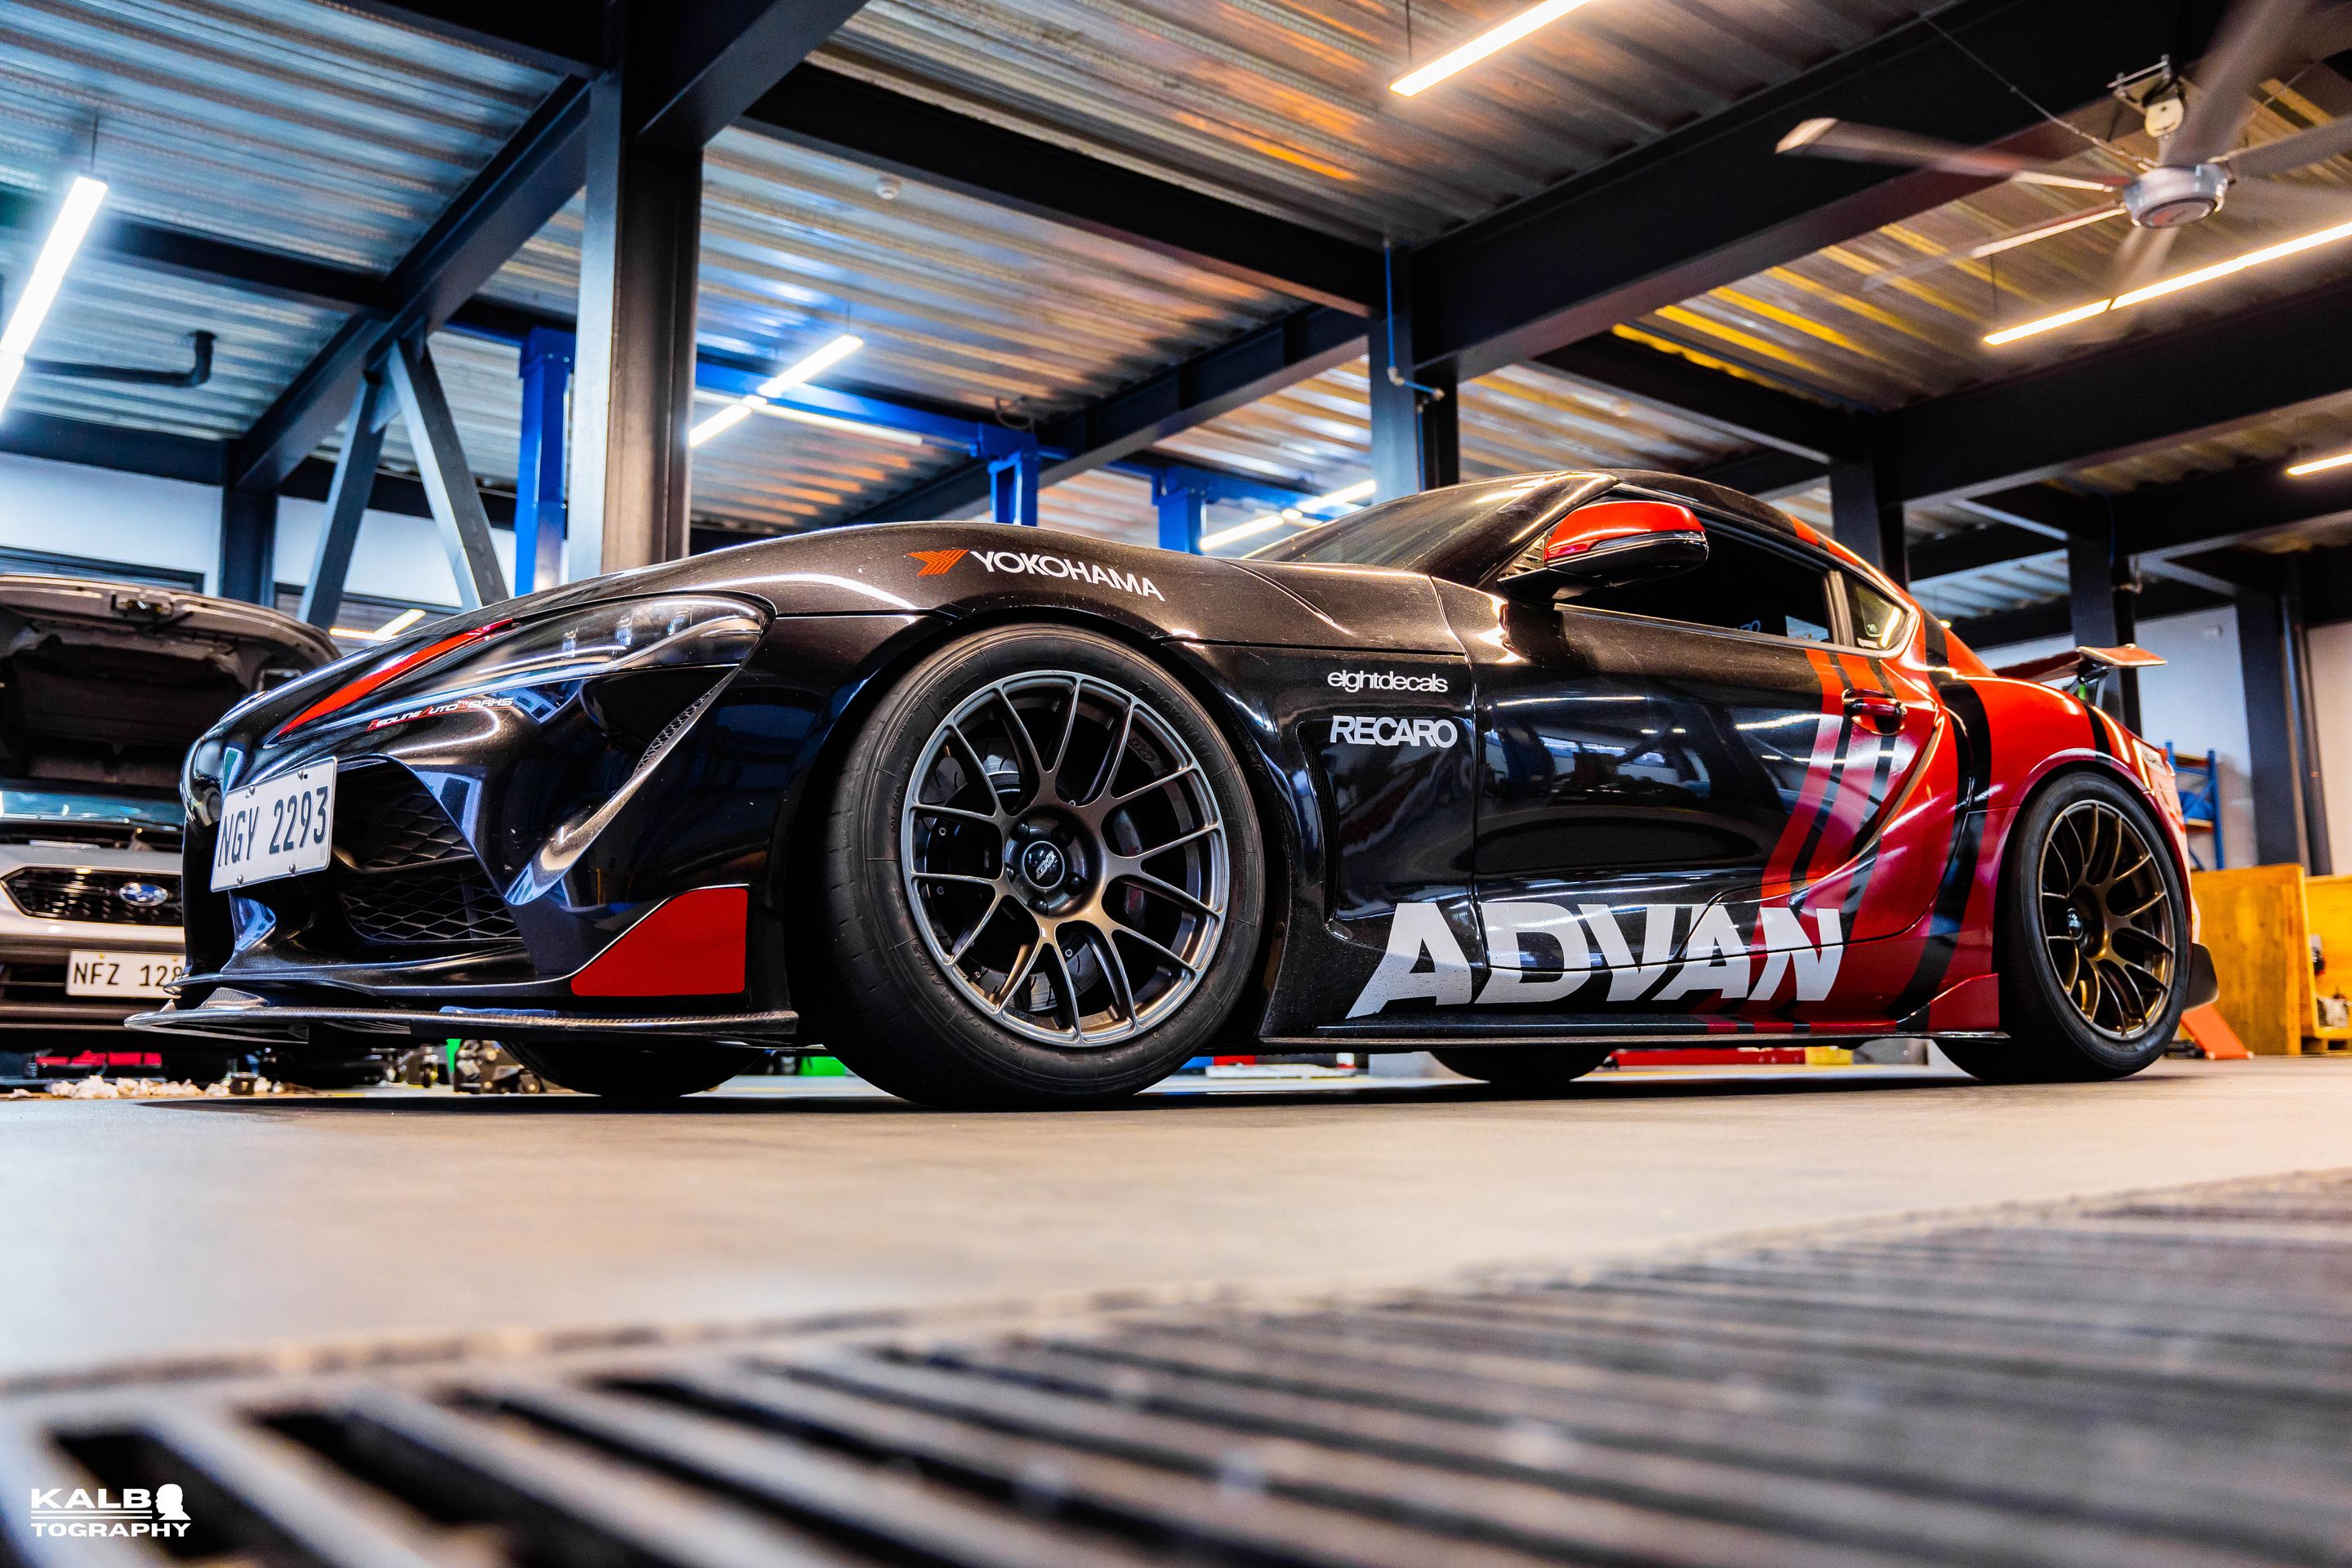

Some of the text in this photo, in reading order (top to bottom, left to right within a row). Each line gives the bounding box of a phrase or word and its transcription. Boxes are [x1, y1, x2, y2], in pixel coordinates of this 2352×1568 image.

[970, 550, 1165, 602] YOKOHAMA
[1327, 670, 1449, 693] eightdecals
[1330, 715, 1458, 749] RECARO
[218, 785, 328, 868] NGY 2293
[74, 961, 120, 987] NFZ
[1345, 902, 1844, 1020] ADVAN
